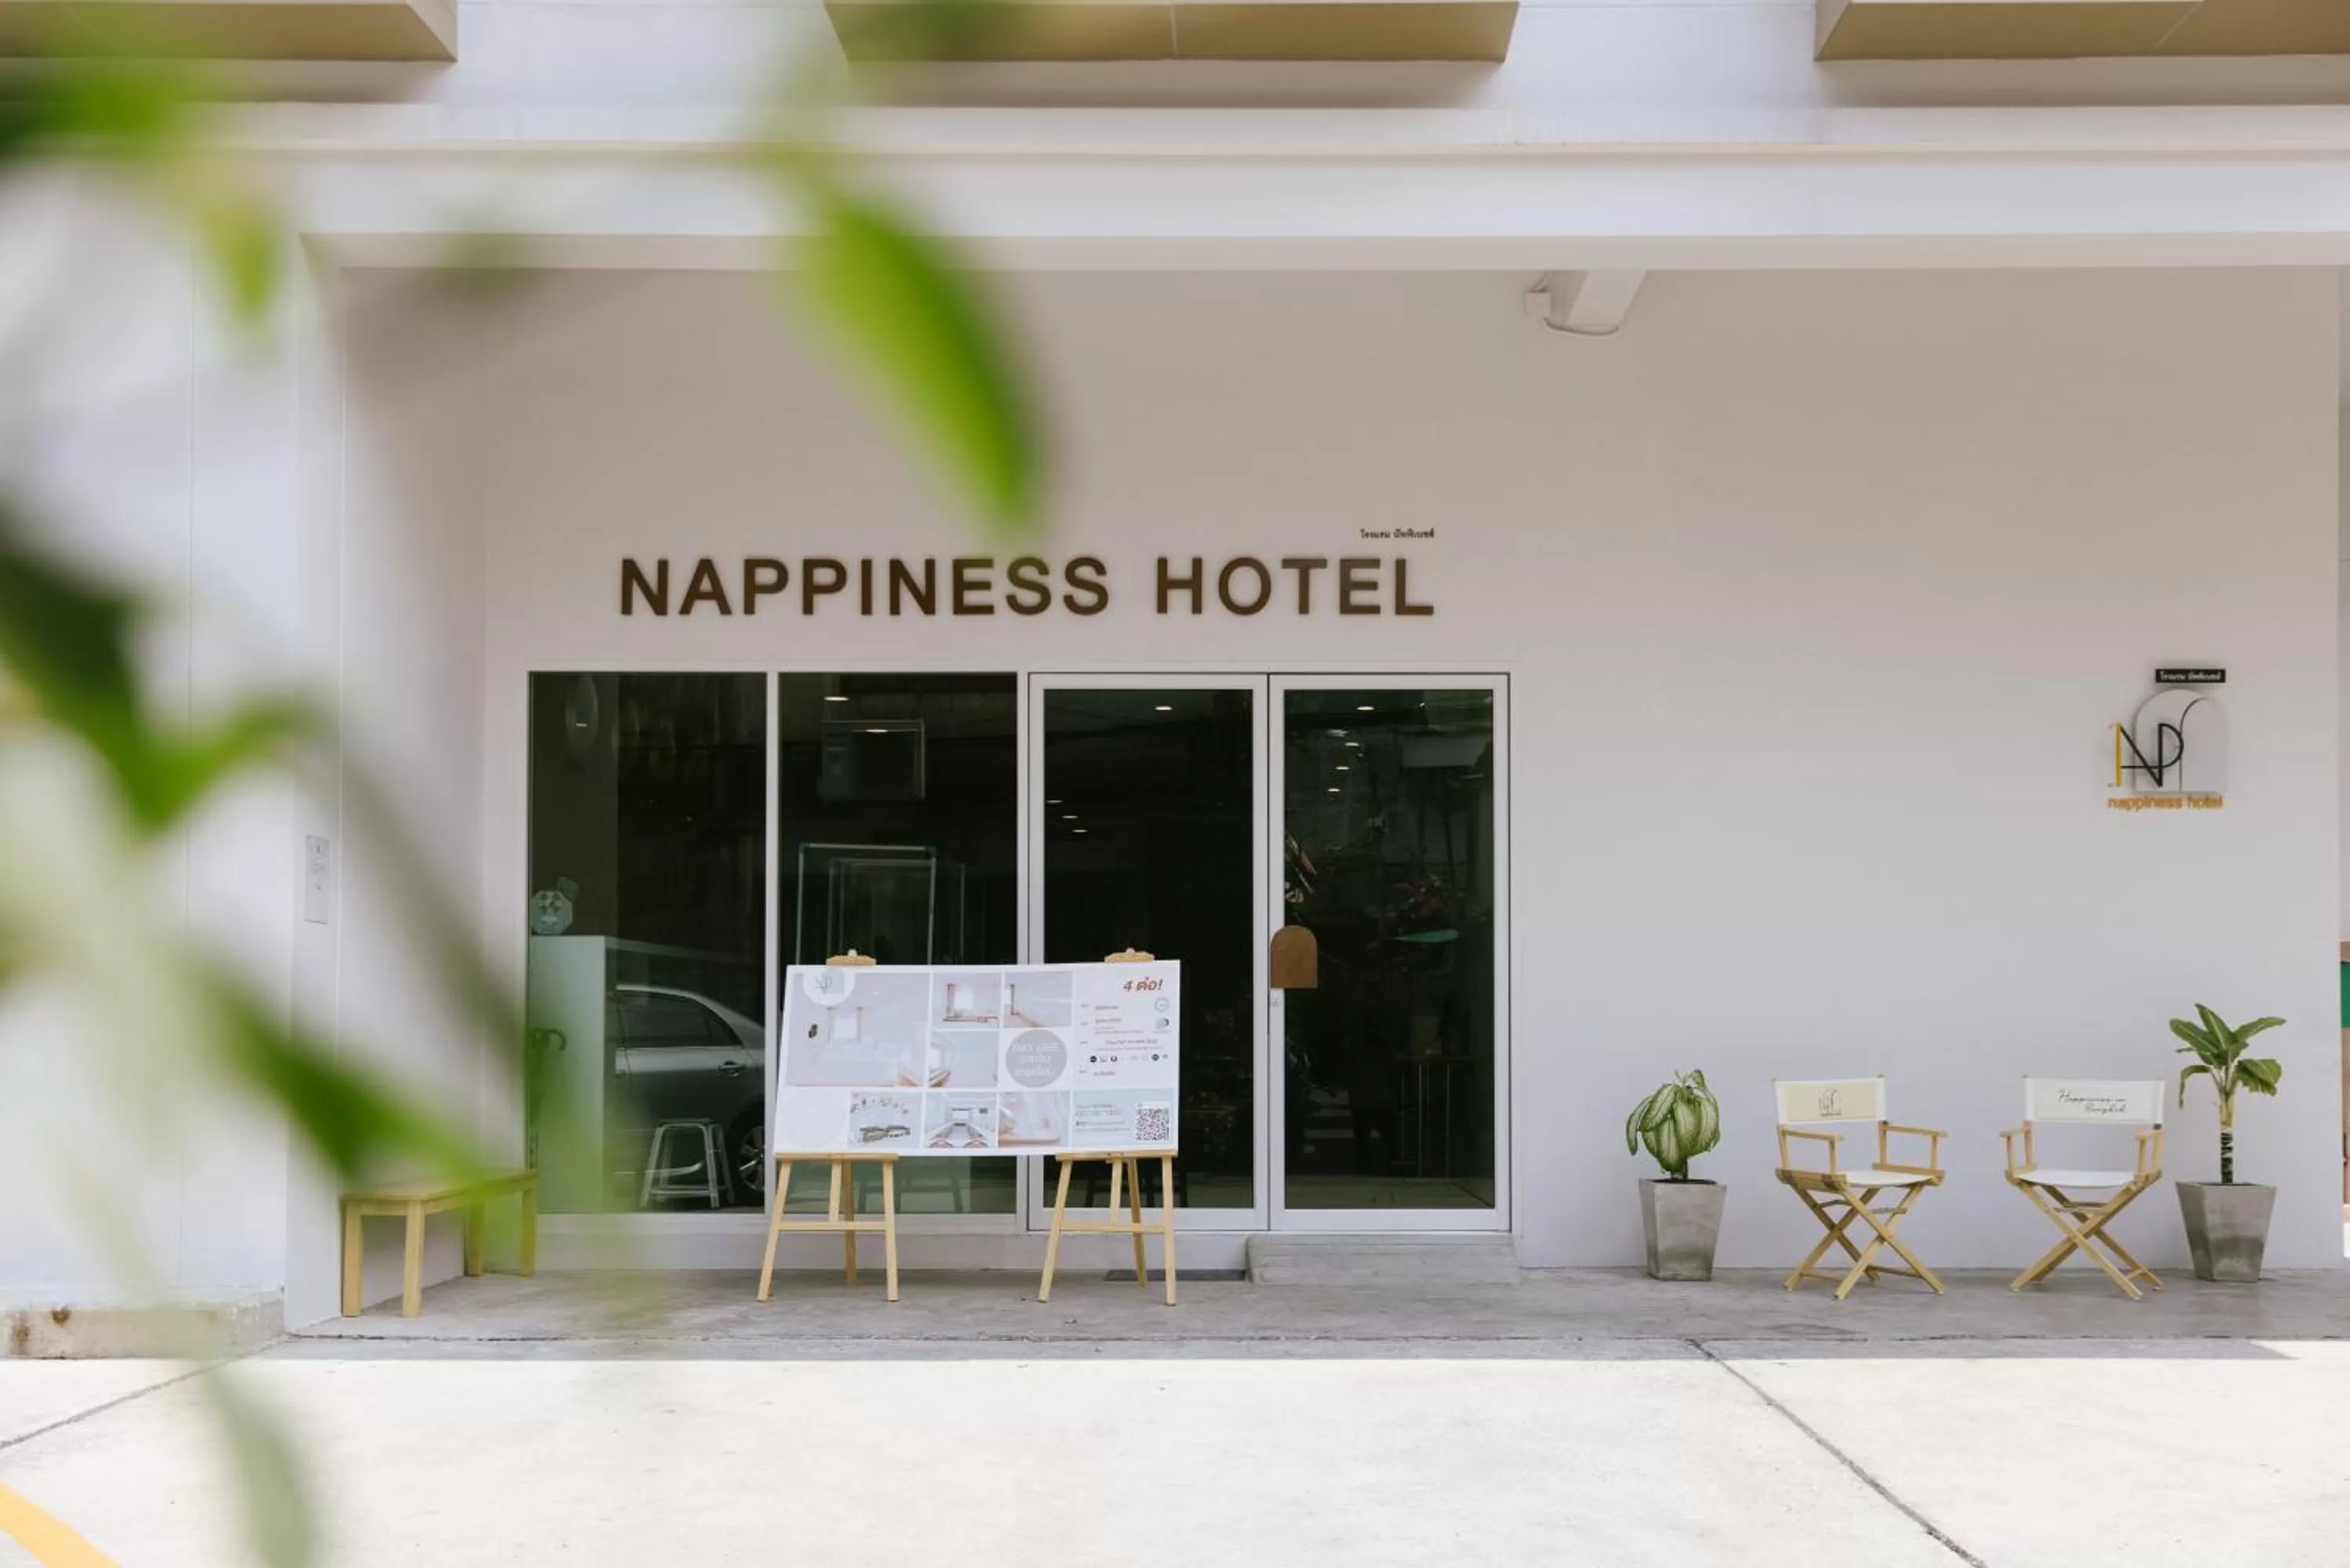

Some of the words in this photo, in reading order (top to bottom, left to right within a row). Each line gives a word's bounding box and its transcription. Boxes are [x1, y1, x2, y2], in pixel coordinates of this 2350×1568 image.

[621, 556, 1109, 616] NAPPINESS
[1156, 557, 1434, 616] HOTEL
[2108, 795, 2183, 811] nappiness
[2187, 794, 2223, 809] hotel
[1123, 980, 1133, 992] 4
